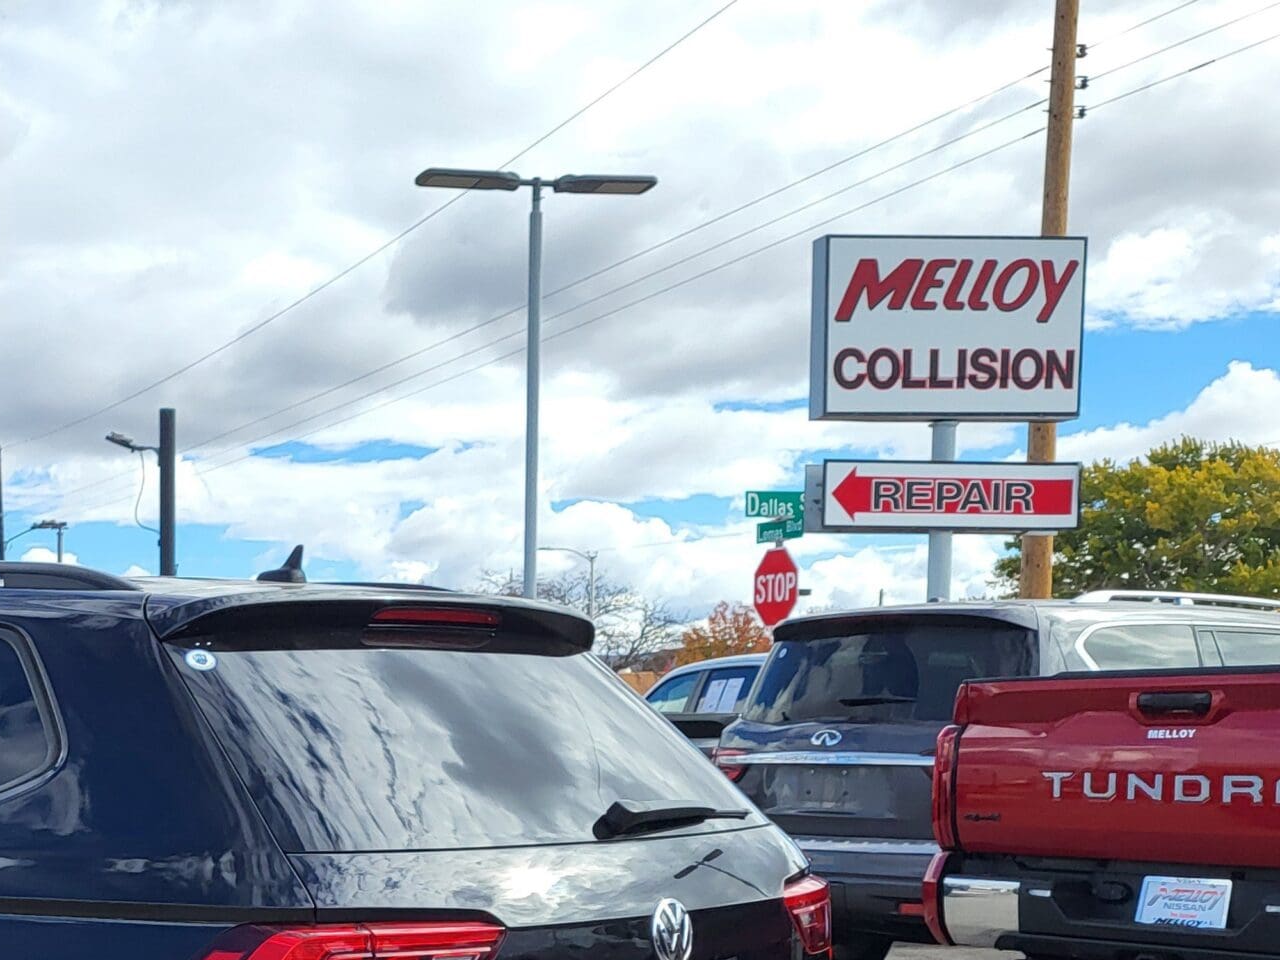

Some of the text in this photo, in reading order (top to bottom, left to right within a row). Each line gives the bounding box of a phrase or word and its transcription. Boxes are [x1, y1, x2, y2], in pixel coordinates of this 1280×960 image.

[834, 258, 1080, 323] MELLOY
[833, 347, 1075, 390] COLLISION
[747, 492, 794, 516] Dallas
[871, 478, 1034, 513] REPAIR
[786, 518, 802, 533] Blvd
[756, 572, 796, 604] STOP
[1147, 728, 1196, 739] MELLOY
[1042, 770, 1280, 804] TUNDR
[1147, 886, 1225, 911] MELLOY
[1163, 902, 1207, 912] NISSAN
